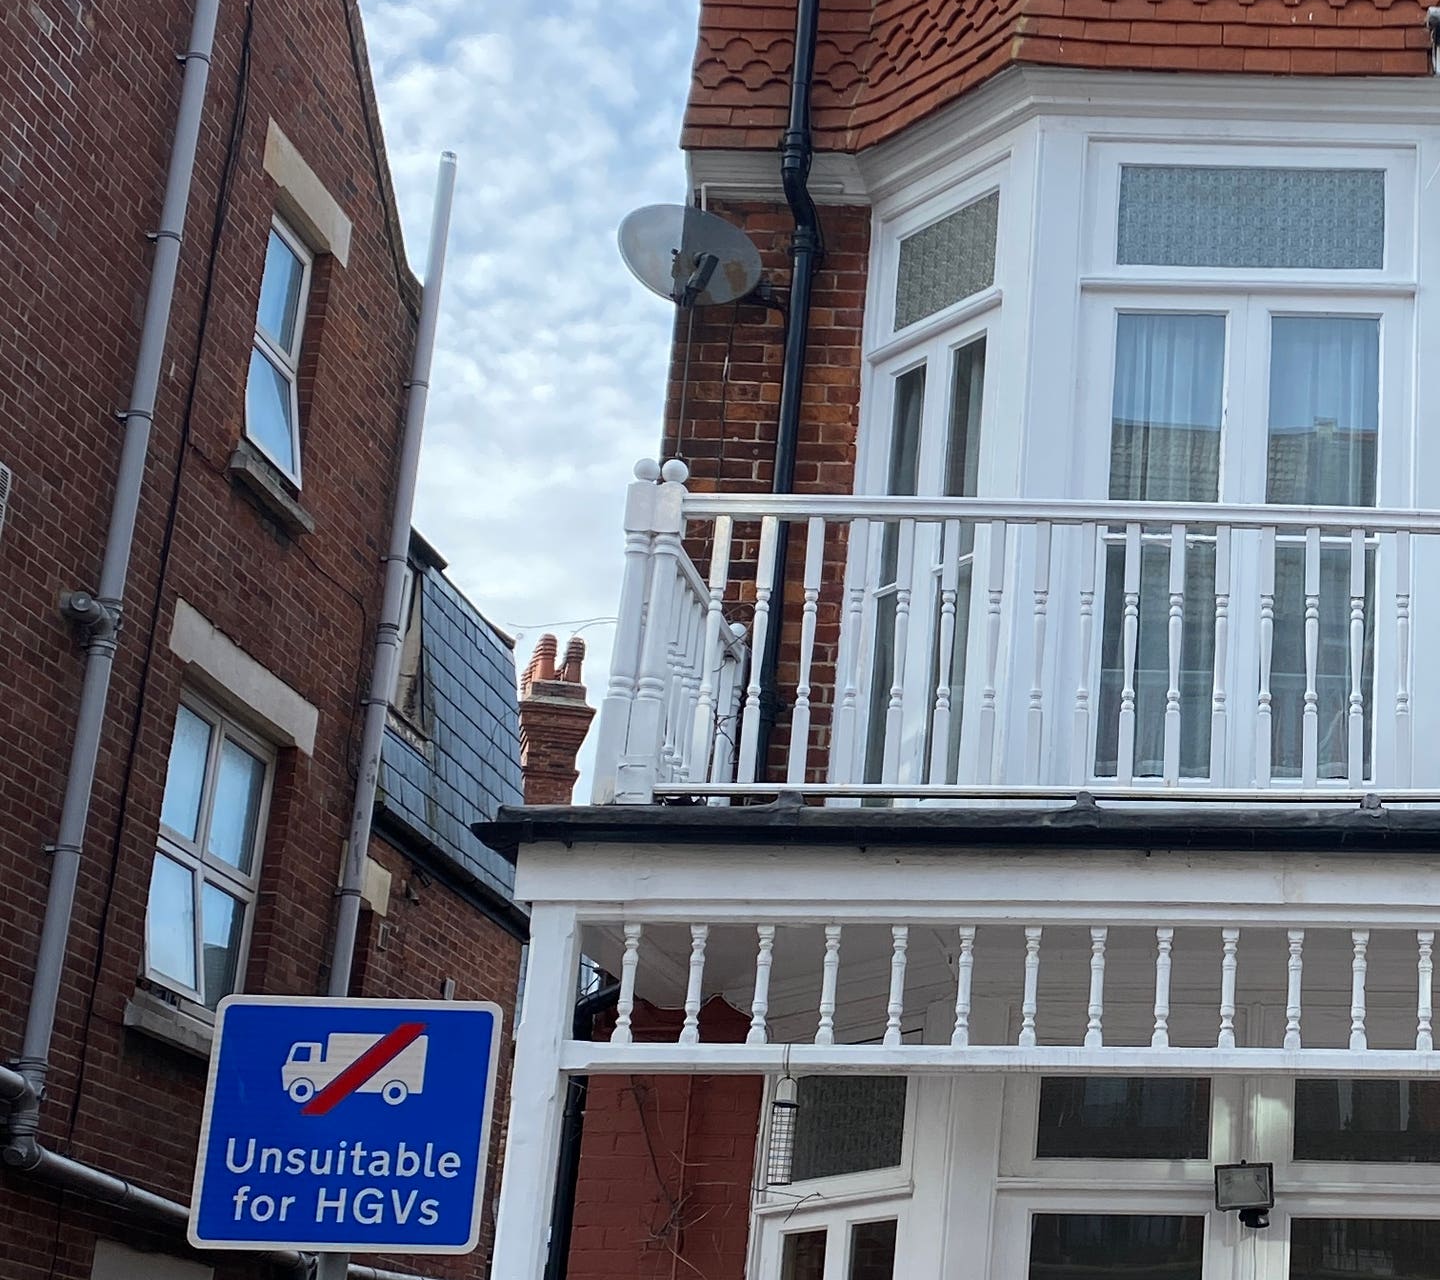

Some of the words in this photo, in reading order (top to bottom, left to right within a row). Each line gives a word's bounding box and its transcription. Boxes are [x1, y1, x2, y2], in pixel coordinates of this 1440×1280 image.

[225, 1137, 462, 1179] Unsuitable
[232, 1185, 296, 1222] for
[315, 1187, 440, 1226] HGVs
